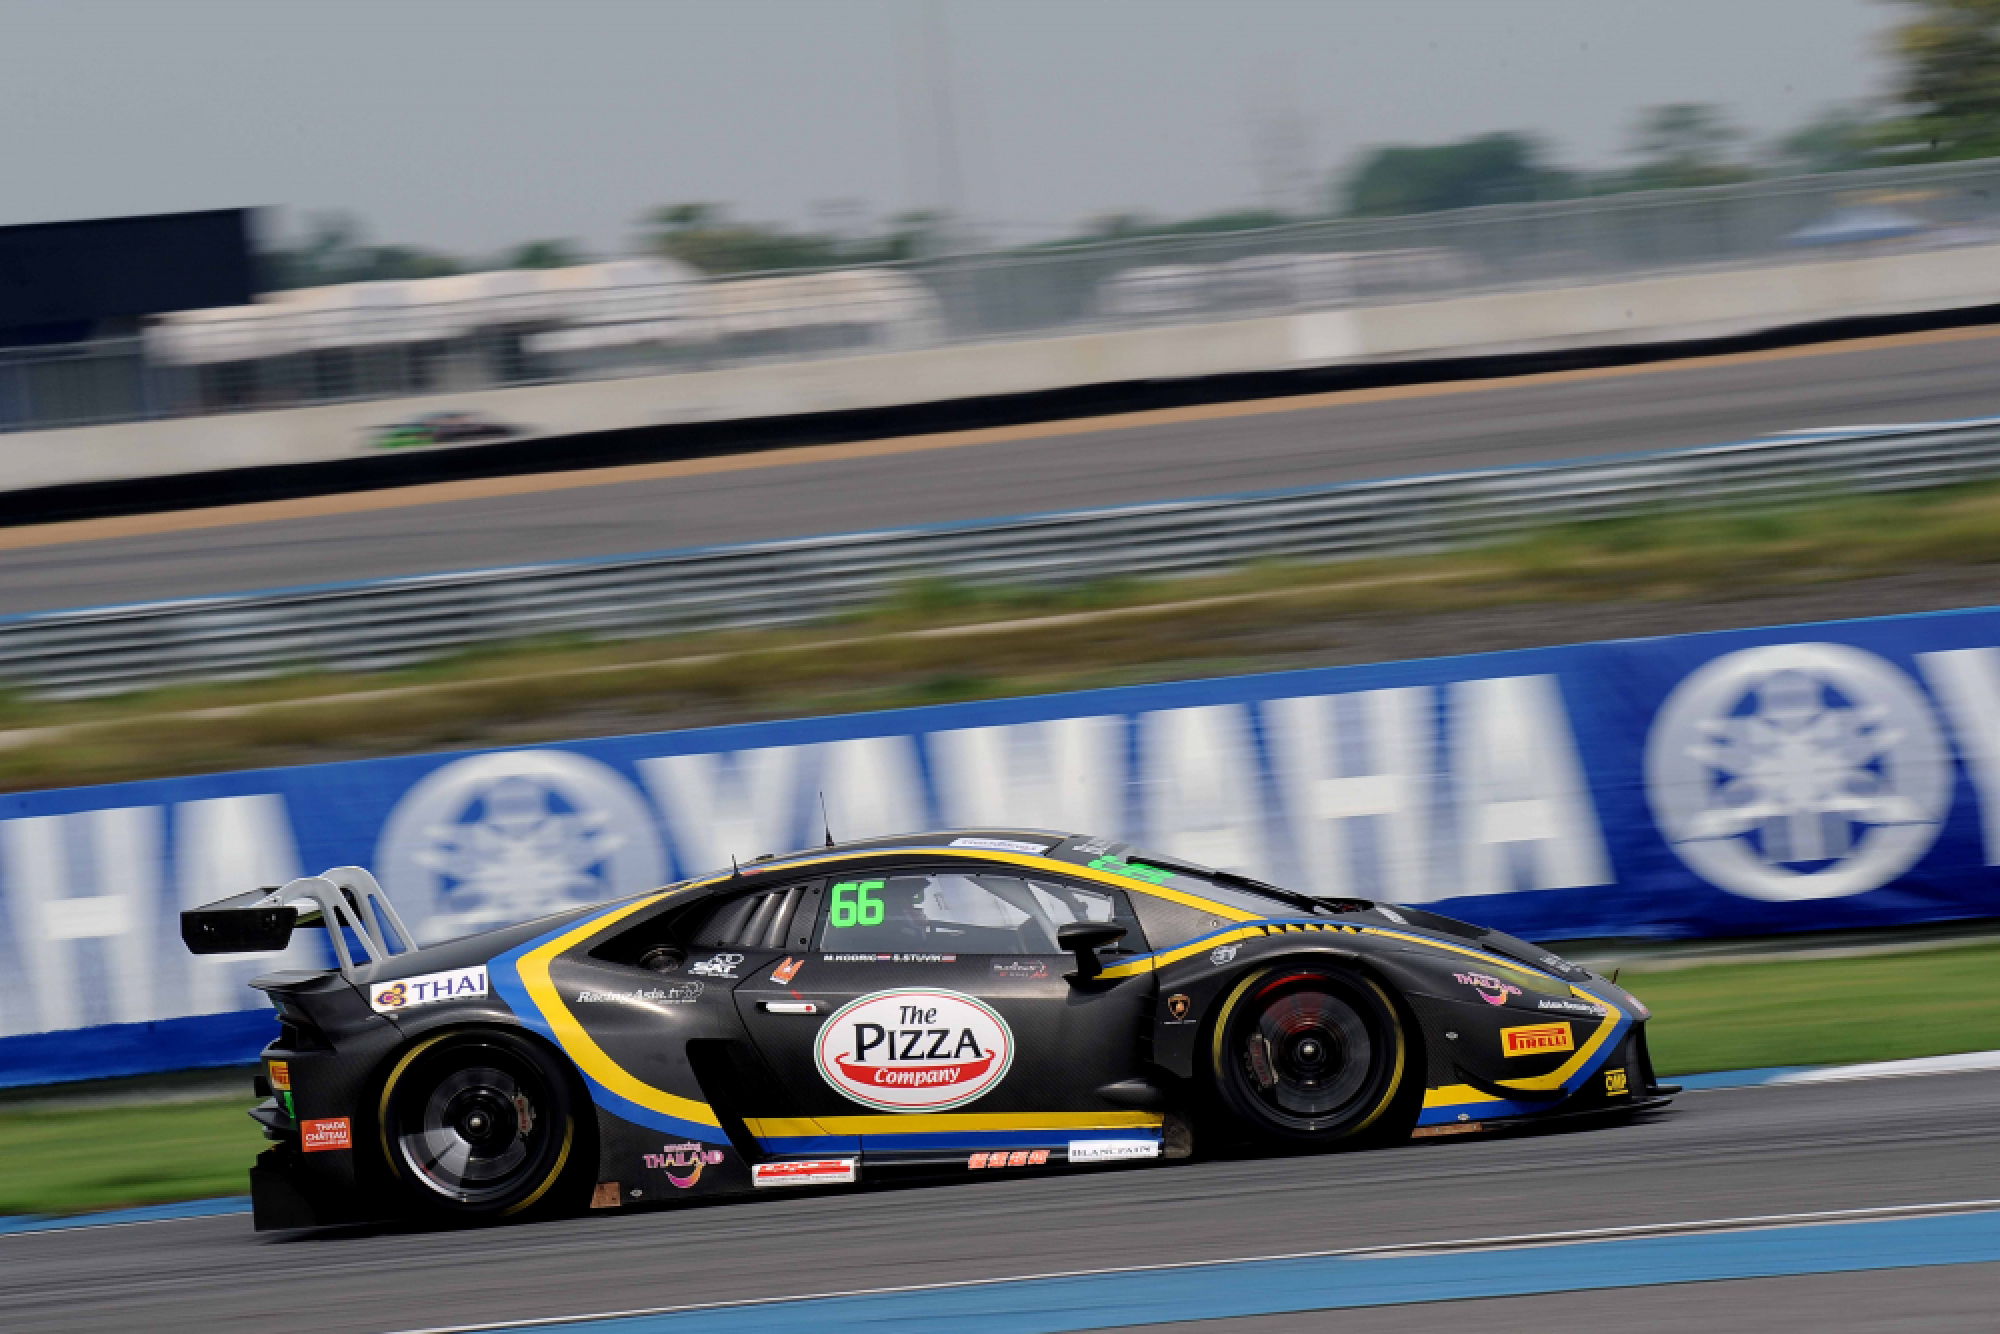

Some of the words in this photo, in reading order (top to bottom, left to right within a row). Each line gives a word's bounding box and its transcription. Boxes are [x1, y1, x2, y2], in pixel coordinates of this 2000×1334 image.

[633, 673, 1617, 906] YAMAHA
[831, 881, 885, 928] 66
[412, 973, 485, 1001] THAI
[900, 1005, 937, 1024] The
[853, 1022, 984, 1062] PIZZA
[1507, 1026, 1567, 1051] PIRELLI
[873, 1066, 961, 1086] Company
[642, 1150, 725, 1168] THAILAND
